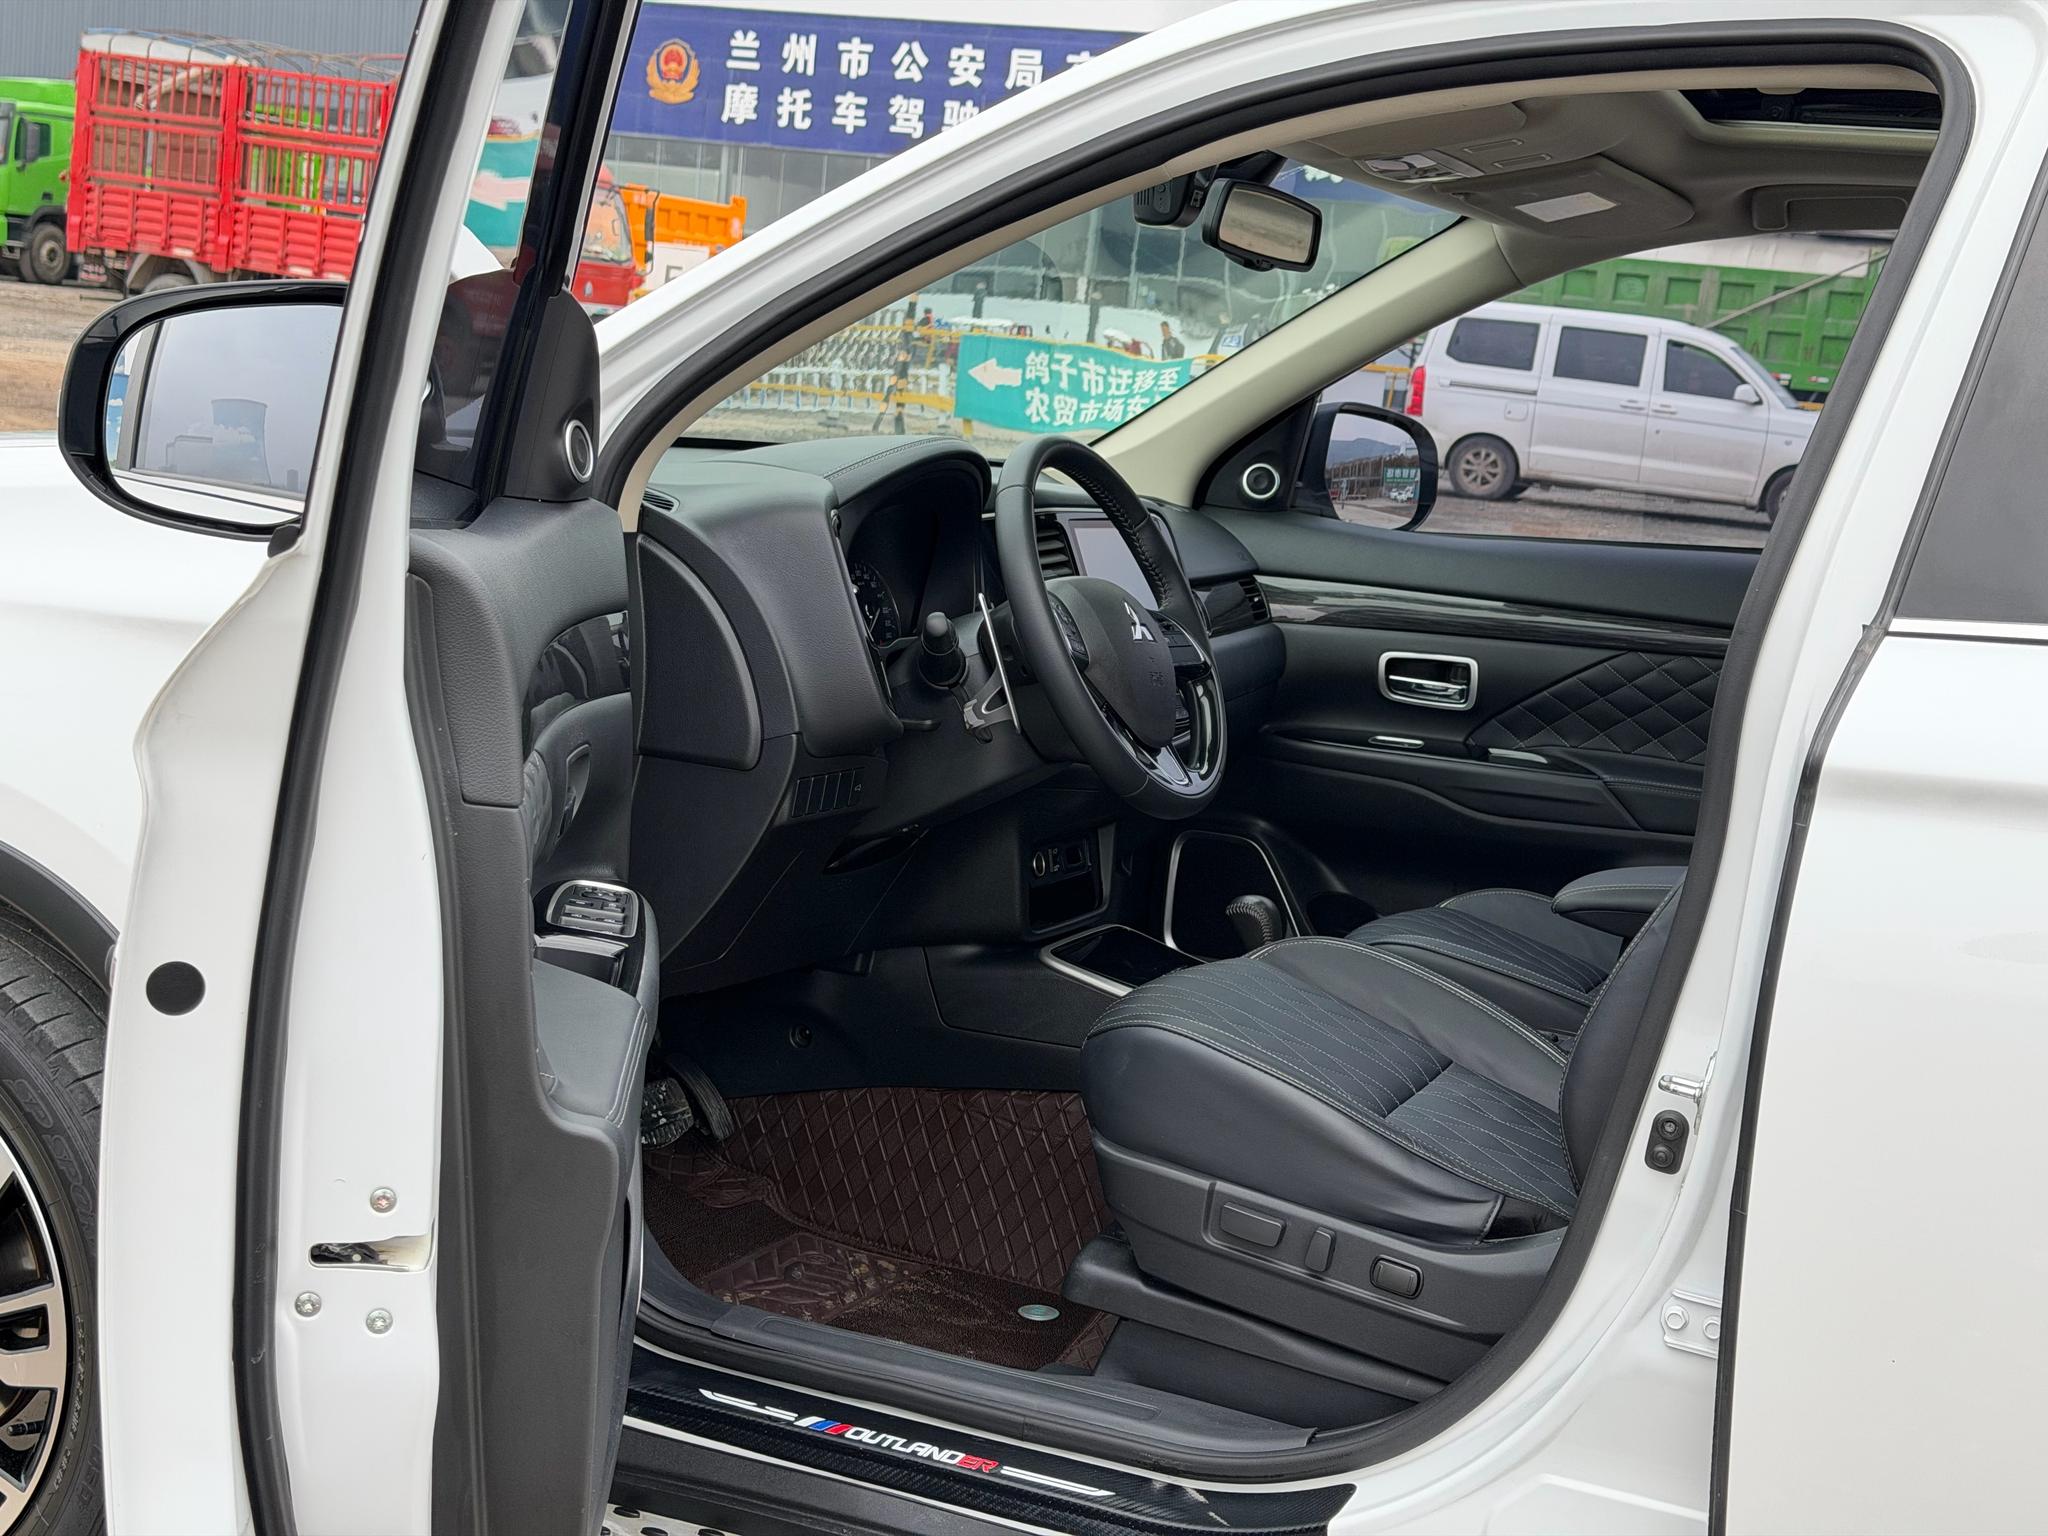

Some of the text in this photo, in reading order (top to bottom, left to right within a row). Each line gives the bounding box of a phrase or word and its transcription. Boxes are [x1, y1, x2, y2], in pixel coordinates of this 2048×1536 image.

[1025, 351, 1182, 397] 鸽子市迁移至
[844, 1426, 999, 1473] OUTLANDER
